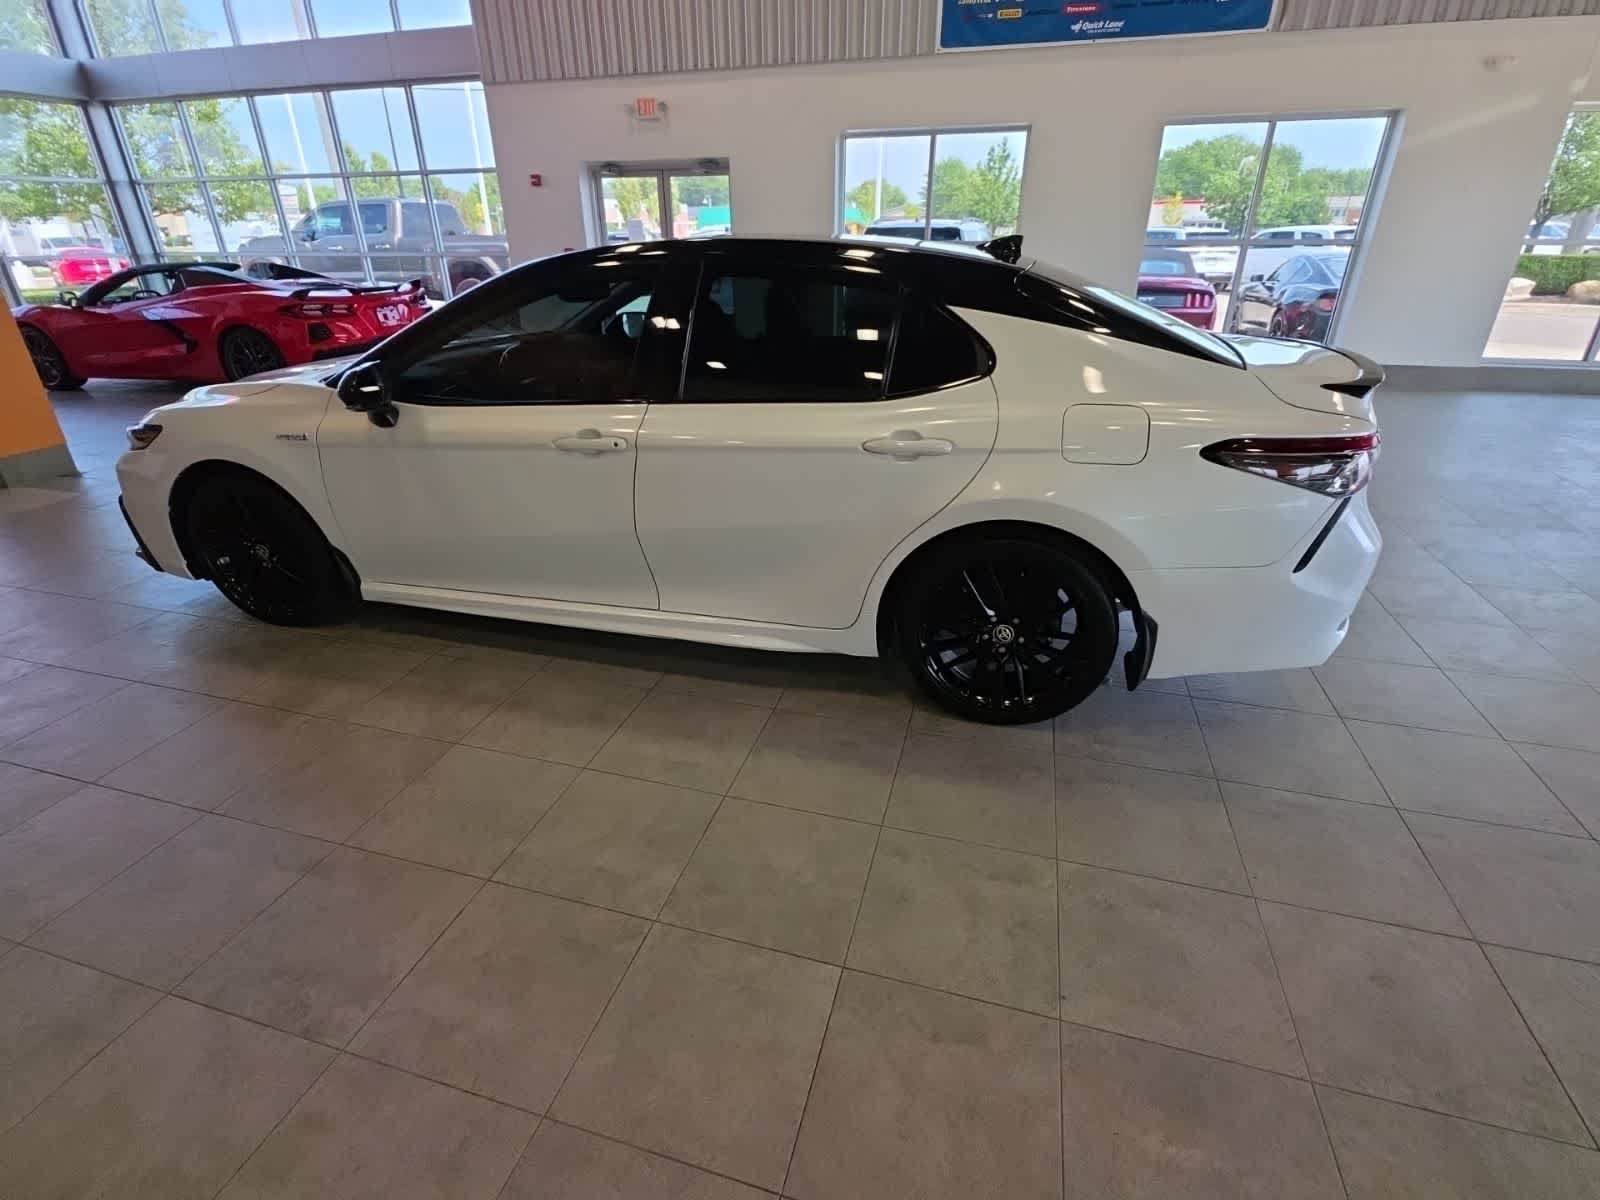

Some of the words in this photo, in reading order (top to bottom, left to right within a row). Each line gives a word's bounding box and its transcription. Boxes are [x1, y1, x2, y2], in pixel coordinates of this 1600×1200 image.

[1082, 20, 1104, 31] Quick
[1103, 19, 1126, 29] Lane
[637, 98, 655, 116] EXIT
